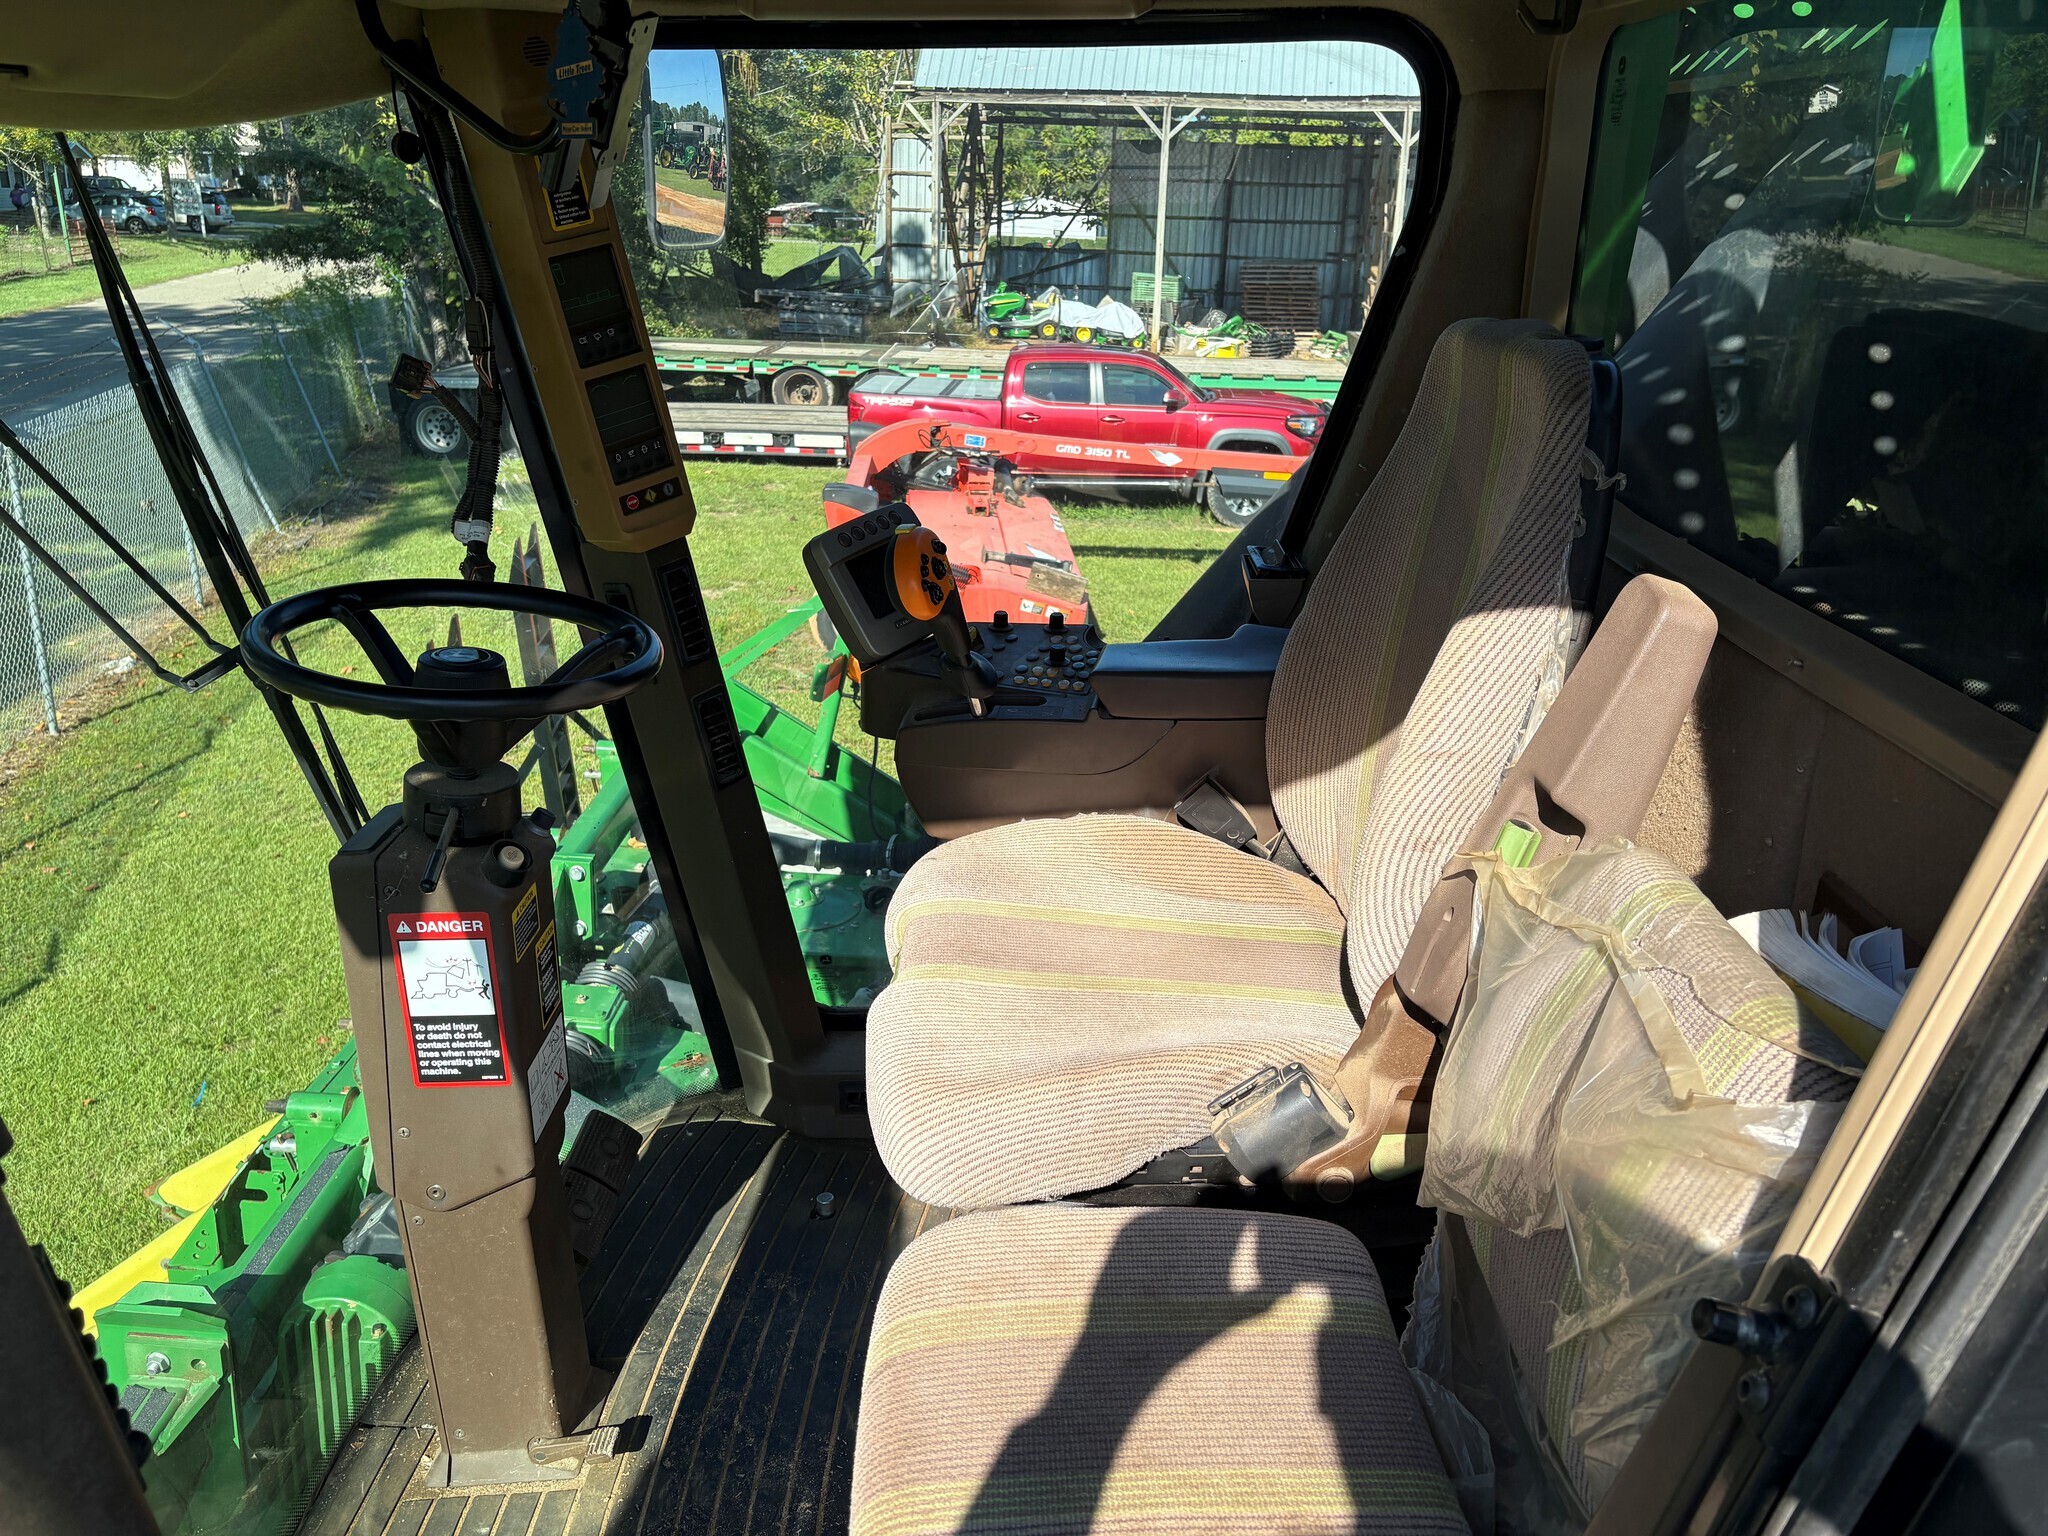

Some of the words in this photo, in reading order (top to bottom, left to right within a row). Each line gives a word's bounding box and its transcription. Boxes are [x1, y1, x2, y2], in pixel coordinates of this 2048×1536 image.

[1055, 444, 1082, 455] GMD
[1084, 447, 1113, 458] 3150
[1115, 449, 1131, 460] TL
[519, 889, 535, 914] CAUTION
[415, 920, 484, 933] DANGER
[413, 1023, 426, 1031] To
[427, 1022, 452, 1031] avoid
[427, 1032, 452, 1040] death
[453, 1031, 466, 1039] do
[467, 1031, 483, 1039] not
[416, 1041, 450, 1049] contact
[451, 1040, 491, 1049] electrical
[418, 1050, 440, 1058] lines
[441, 1049, 466, 1057] when
[467, 1049, 500, 1058] moving
[431, 1058, 473, 1068] operating
[474, 1057, 492, 1065] this
[420, 1067, 462, 1075] machine.
